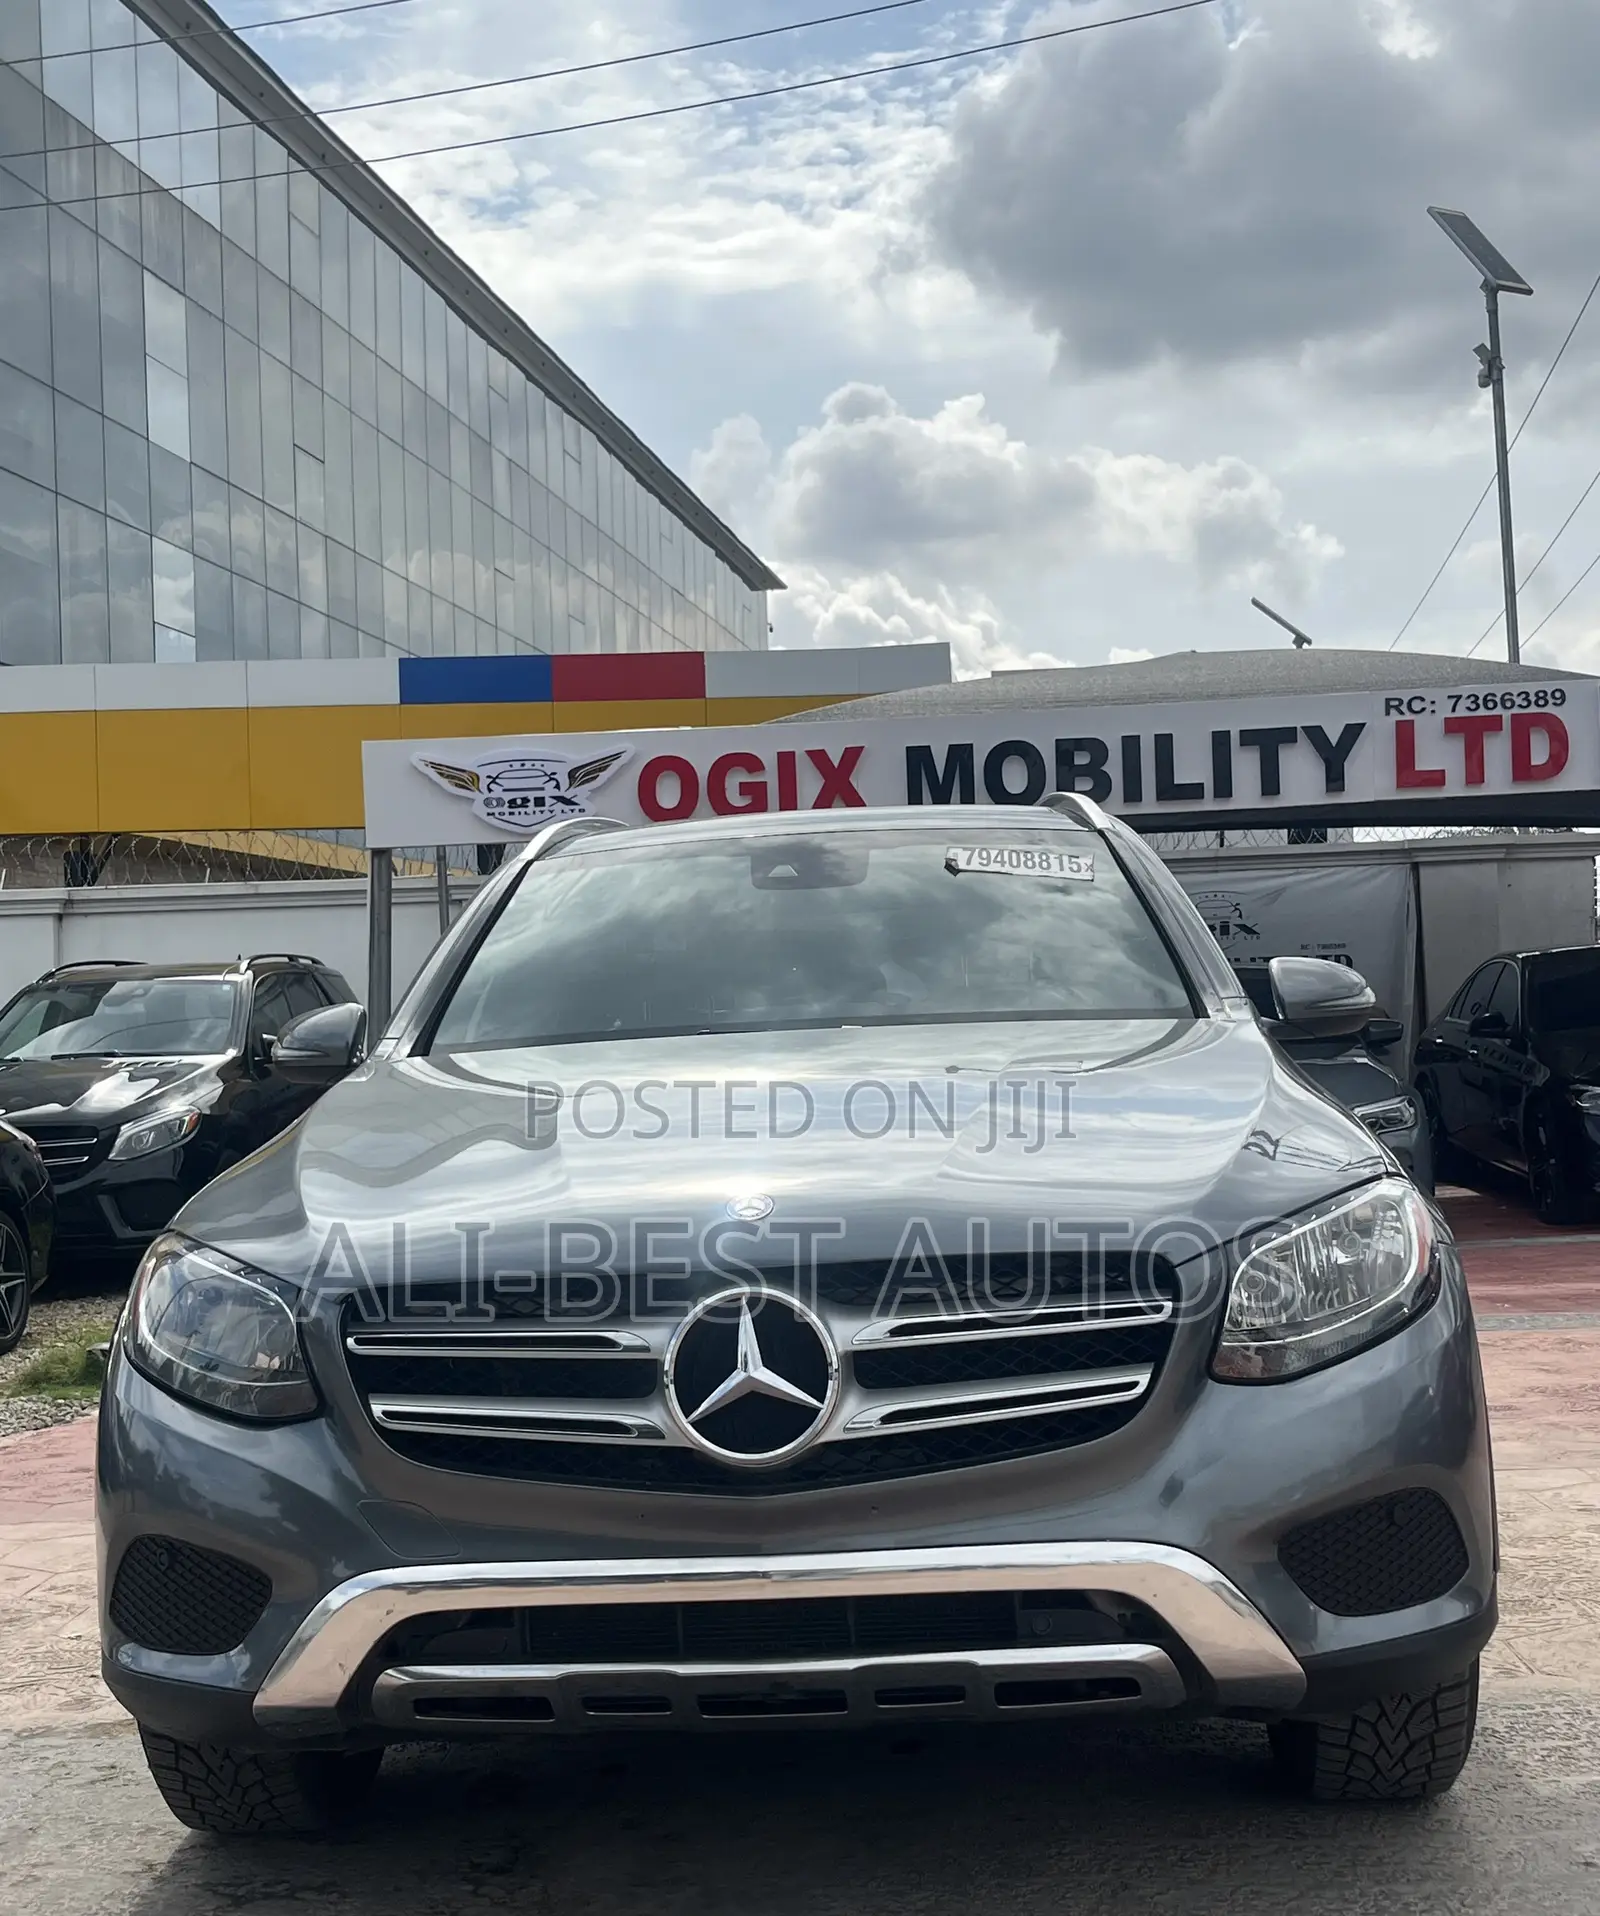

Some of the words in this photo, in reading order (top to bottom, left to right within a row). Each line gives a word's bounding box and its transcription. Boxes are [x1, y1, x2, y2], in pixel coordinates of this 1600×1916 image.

[1384, 695, 1437, 717] RC:
[1446, 688, 1567, 713] 7366389
[636, 745, 868, 822] OGIX
[904, 721, 1367, 805] MOBILITY
[1394, 711, 1570, 790] LTD
[486, 808, 556, 817] MOBILITY
